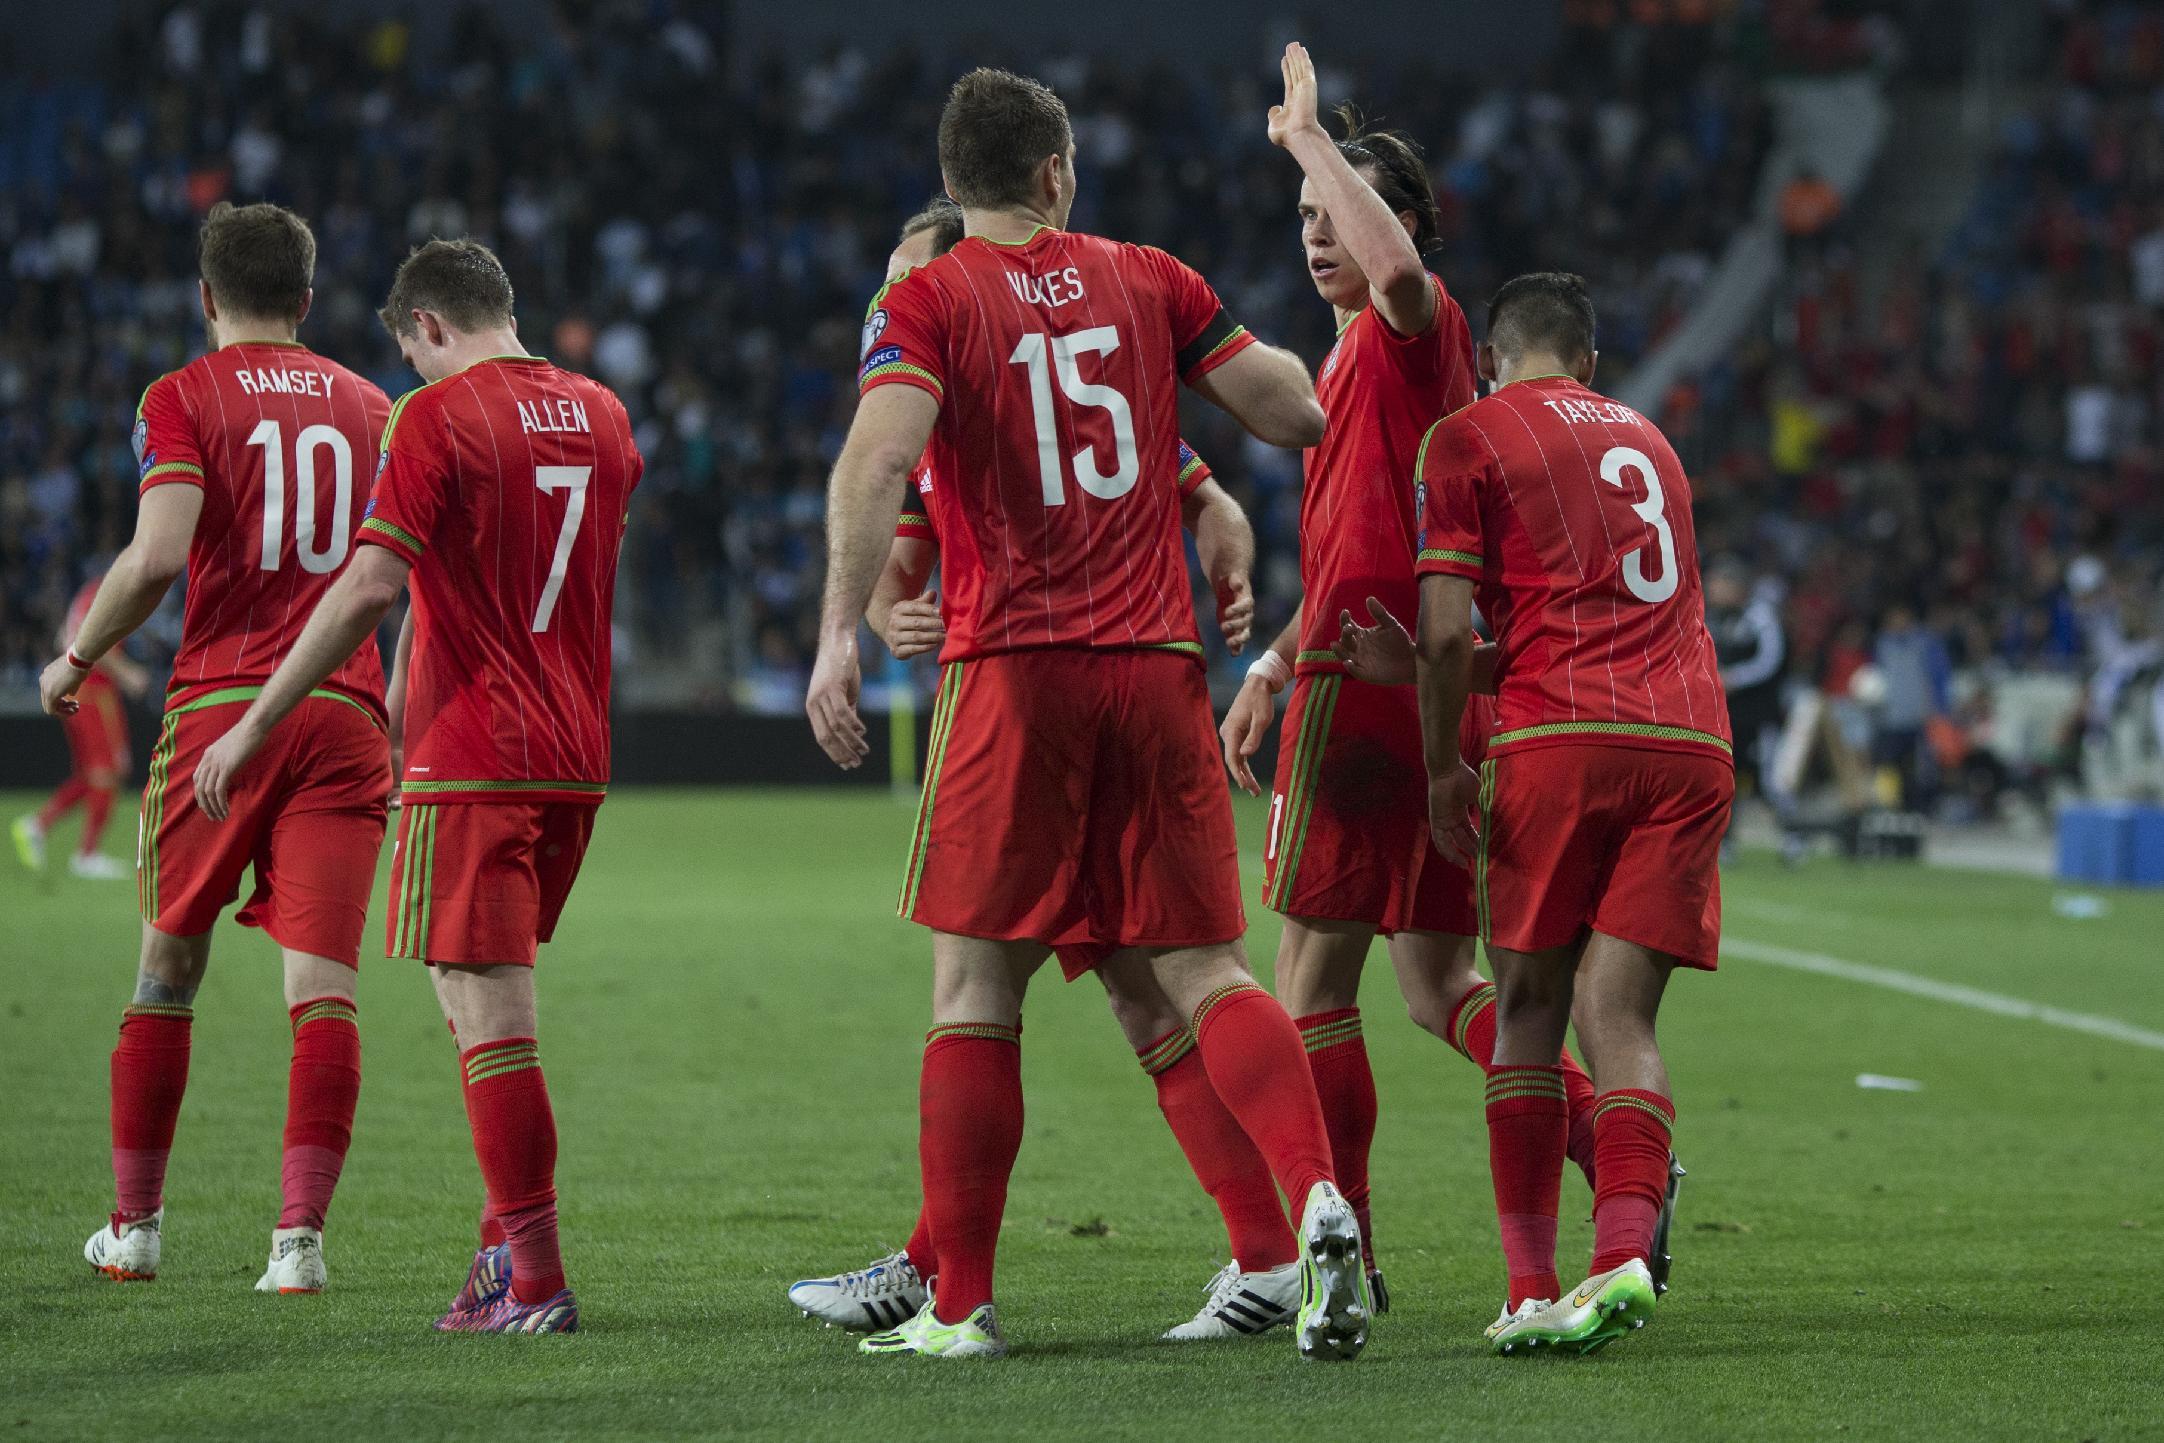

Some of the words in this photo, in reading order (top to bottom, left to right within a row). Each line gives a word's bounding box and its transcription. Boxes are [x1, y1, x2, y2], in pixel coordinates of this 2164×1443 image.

[235, 368, 335, 399] RAMSEY
[863, 350, 901, 373] SPECT
[517, 400, 590, 434] ALLEN
[1008, 325, 1140, 506] 15
[1543, 400, 1643, 427] TAYLOR
[247, 419, 353, 575] 10
[1599, 446, 1679, 603] 3
[532, 465, 593, 633] 7
